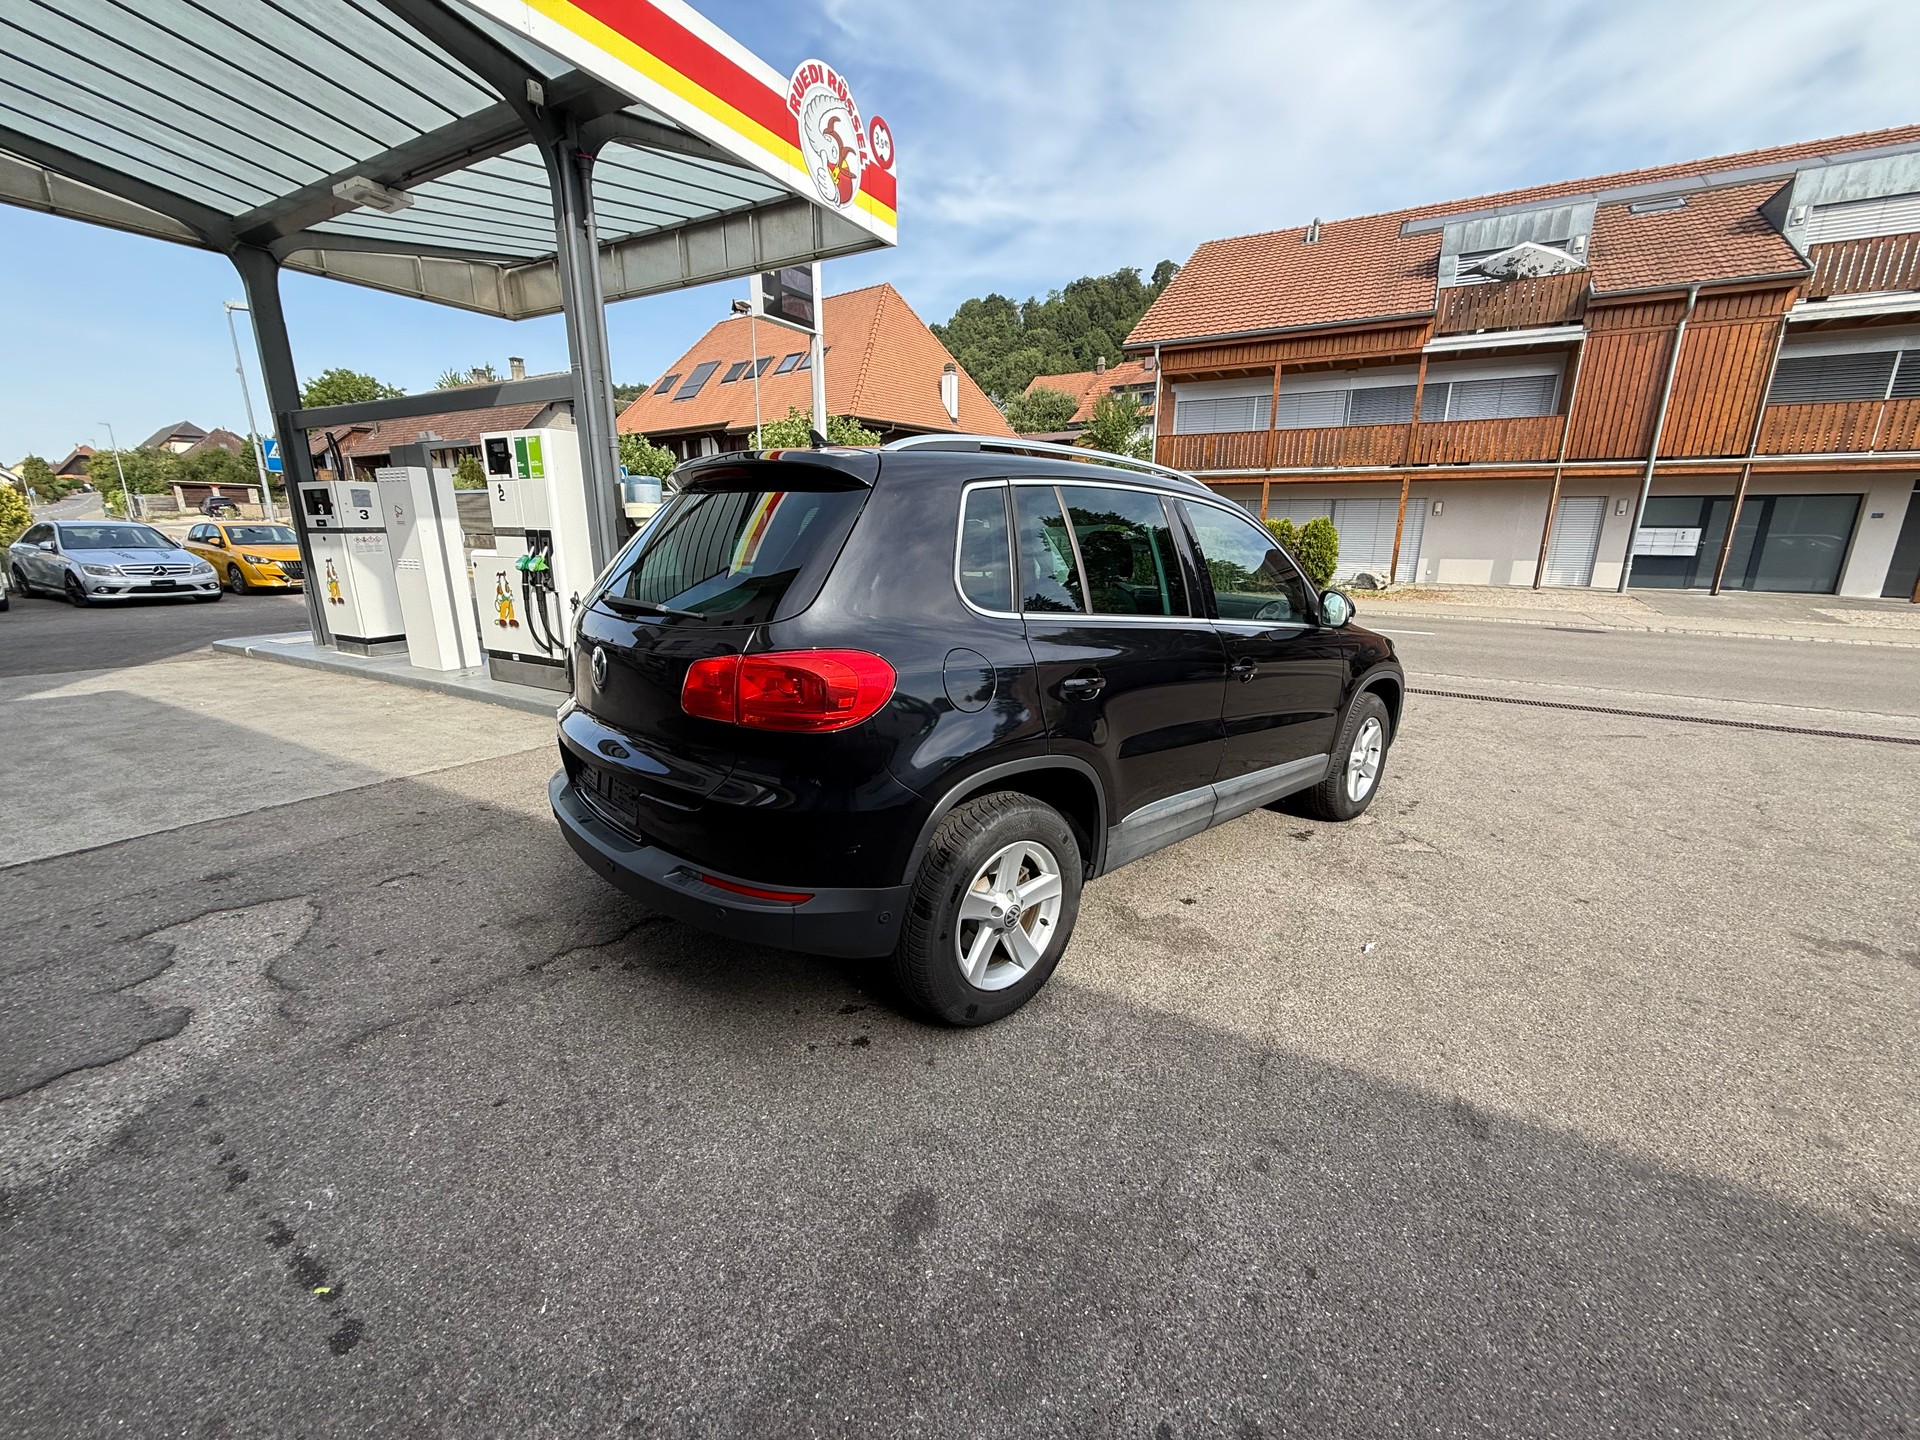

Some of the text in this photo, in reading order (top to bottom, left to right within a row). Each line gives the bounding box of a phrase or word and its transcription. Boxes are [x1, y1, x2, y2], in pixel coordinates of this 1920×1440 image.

[790, 64, 868, 165] RUEDI RÜSSEL
[498, 488, 506, 502] 2
[318, 503, 325, 515] 3
[359, 509, 370, 520] 3
